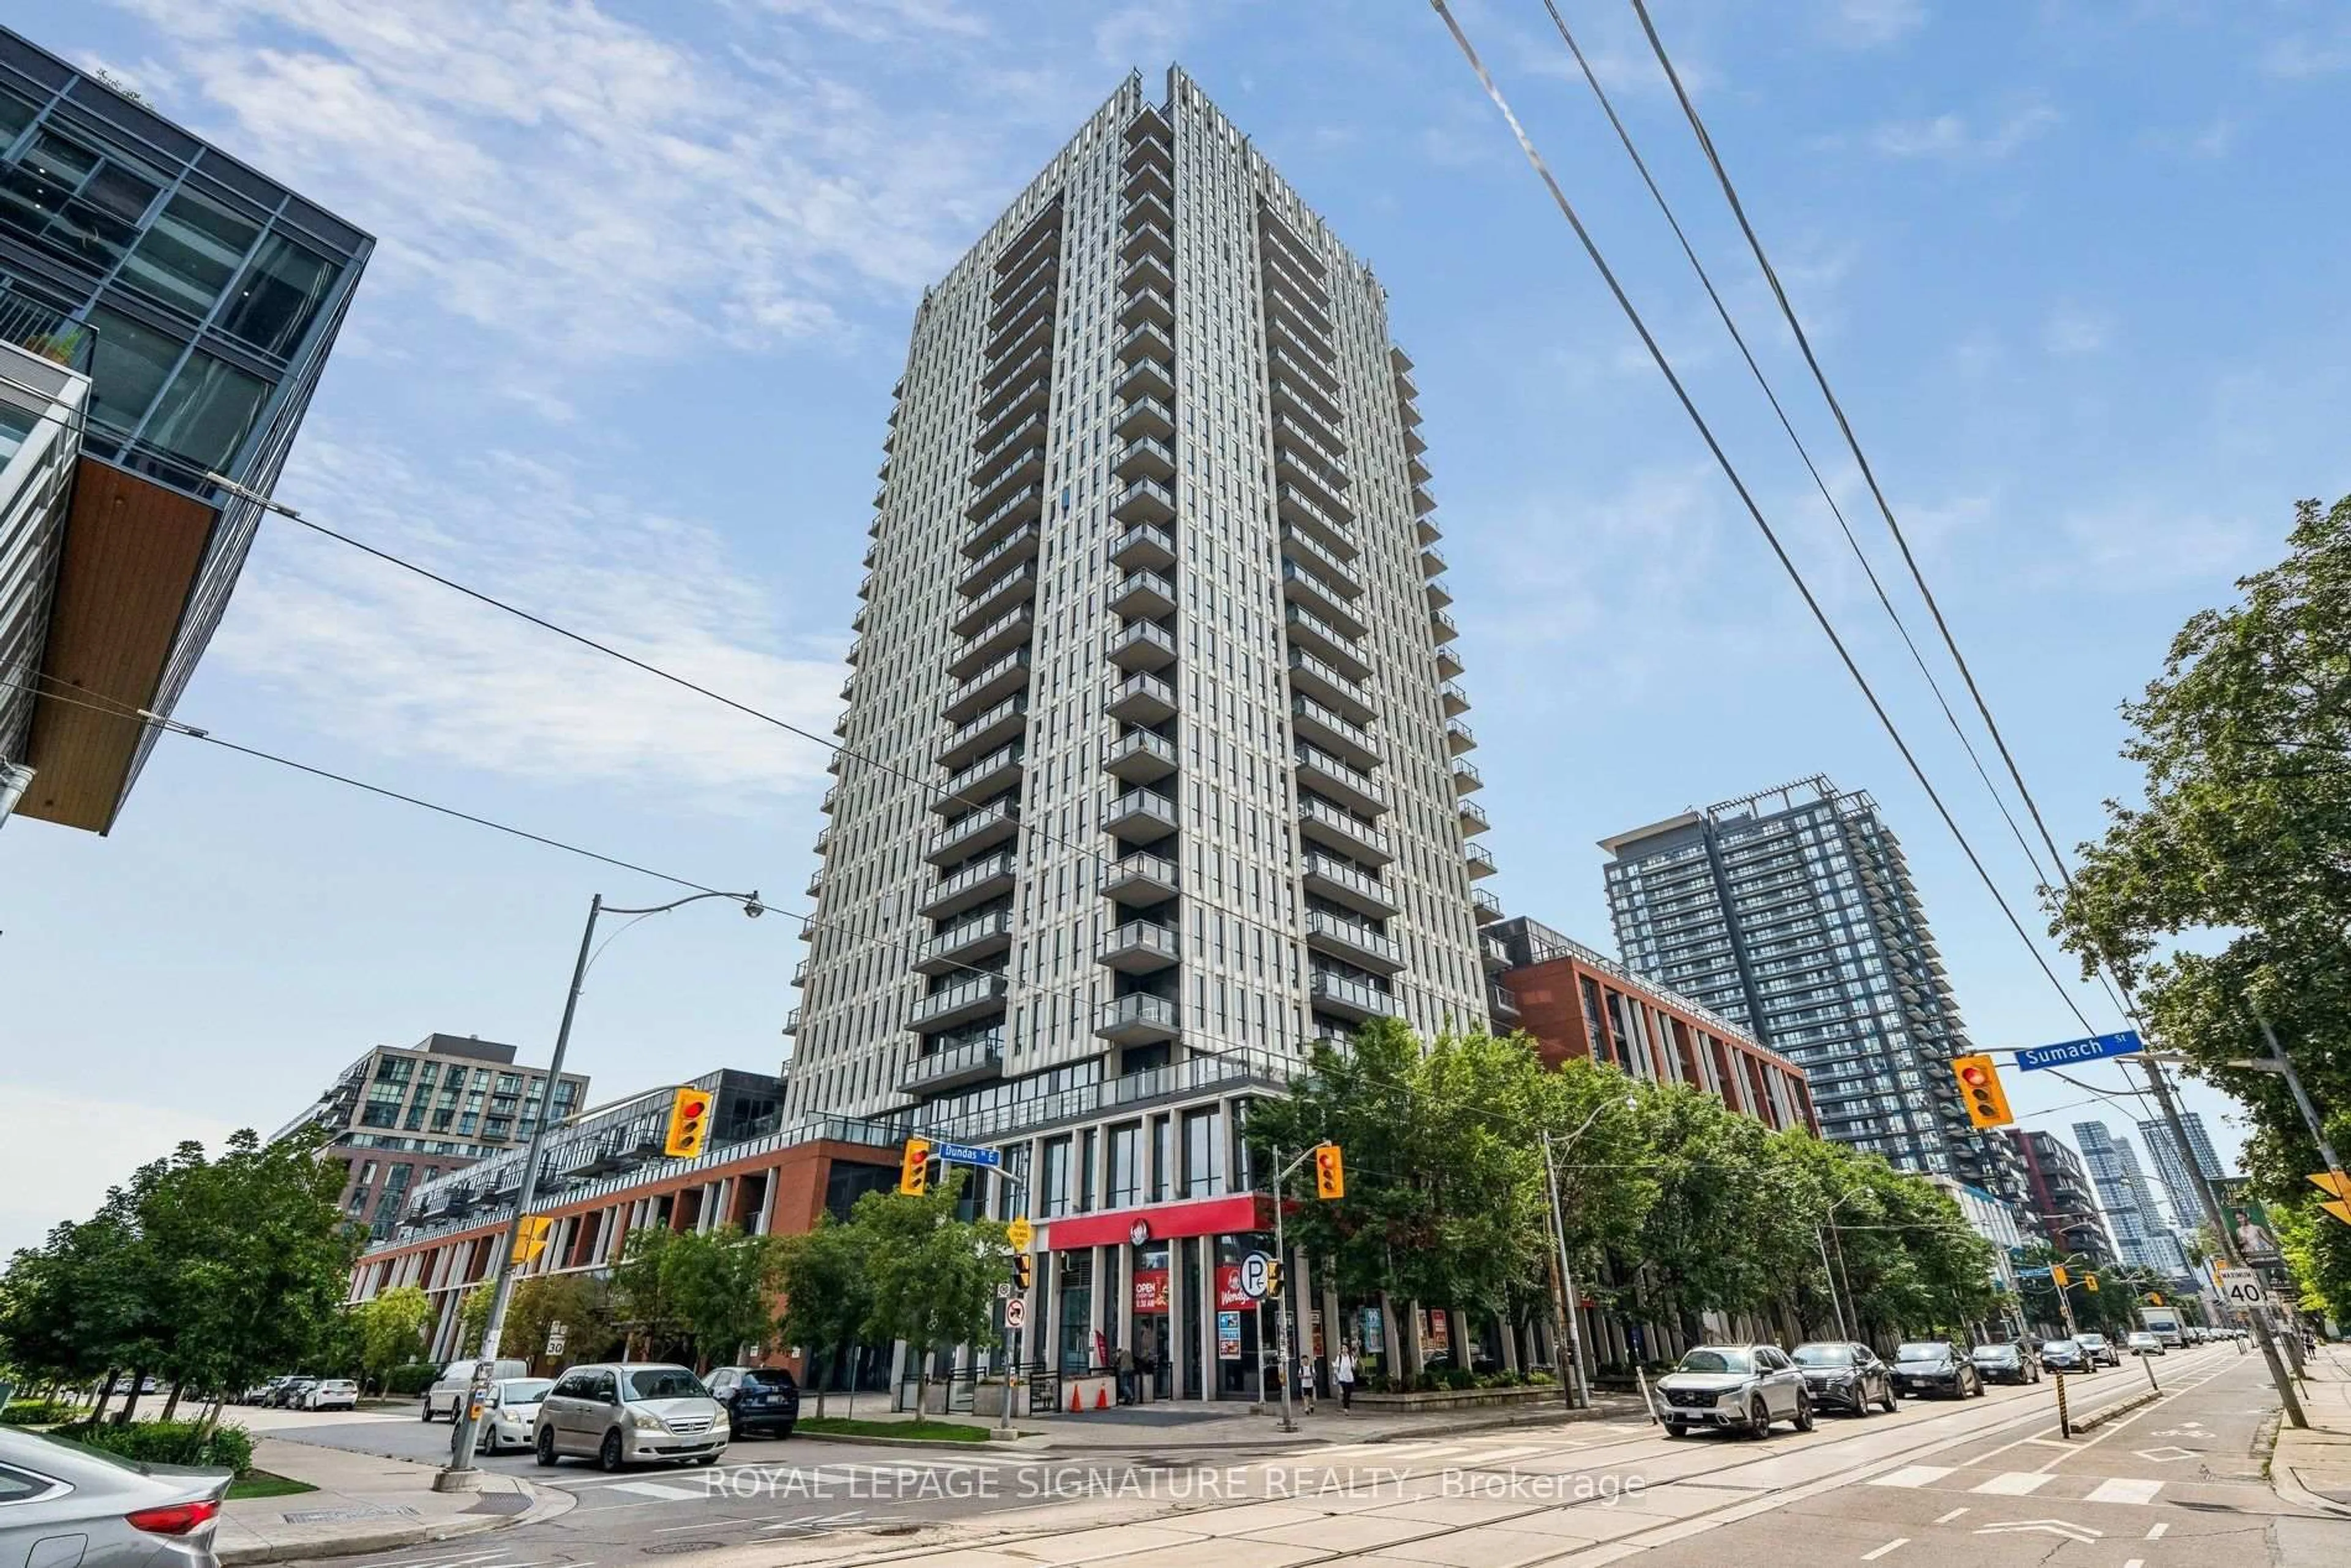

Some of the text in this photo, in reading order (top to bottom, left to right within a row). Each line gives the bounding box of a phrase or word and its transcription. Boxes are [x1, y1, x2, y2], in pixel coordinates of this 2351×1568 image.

[2025, 1034, 2127, 1064] Sumach St
[945, 1146, 977, 1159] Dundas
[988, 1152, 995, 1162] E
[1136, 1283, 1155, 1292] OPEN
[2231, 1284, 2259, 1302] 40
[548, 1343, 563, 1353] 30
